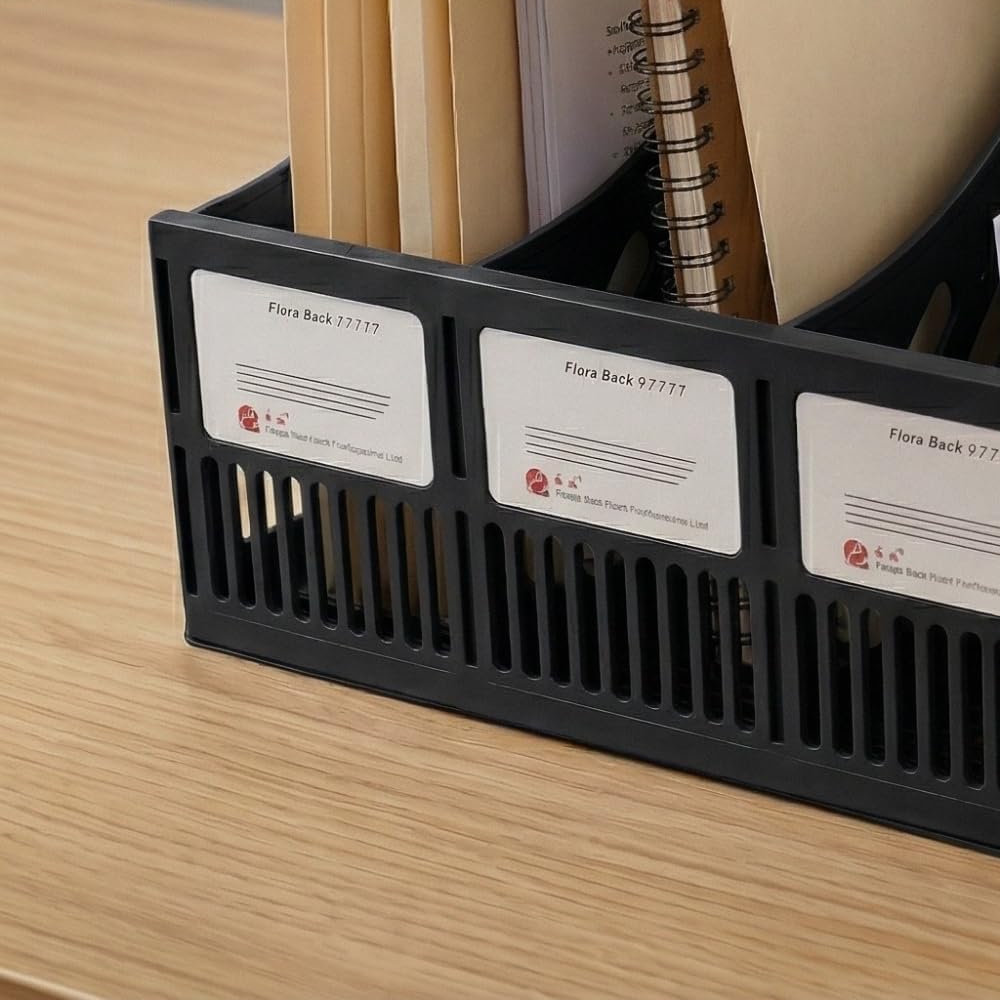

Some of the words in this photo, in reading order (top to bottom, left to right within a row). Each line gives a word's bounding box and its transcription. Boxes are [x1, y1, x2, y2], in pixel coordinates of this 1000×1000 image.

[268, 302, 299, 319] Flora
[303, 309, 333, 326] Back
[564, 361, 597, 379] Flora
[601, 369, 634, 387] Back
[637, 376, 687, 398] 97777
[889, 427, 924, 446] Flora
[928, 435, 963, 455] Back
